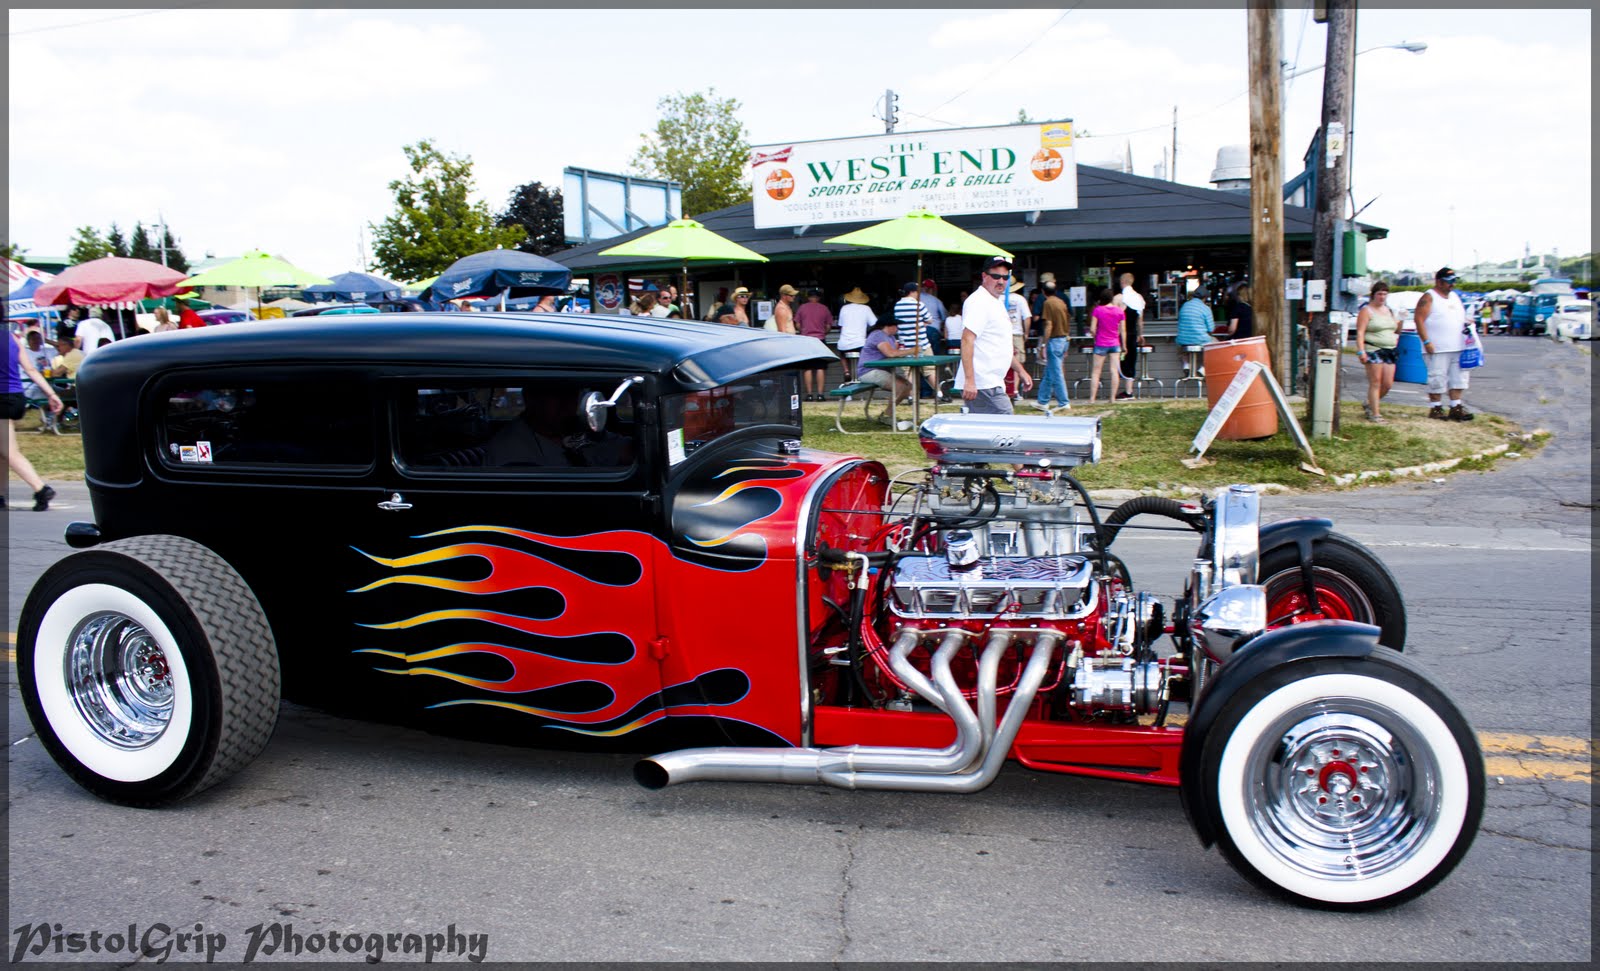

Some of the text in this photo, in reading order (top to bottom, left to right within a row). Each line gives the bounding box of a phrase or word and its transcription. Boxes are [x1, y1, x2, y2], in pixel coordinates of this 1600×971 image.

[889, 142, 928, 153] THE
[806, 147, 1016, 183] WEST END
[808, 172, 1015, 197] SPORTS DECK BAR & GRILLE
[972, 189, 1008, 199] MULTIPLE
[826, 200, 844, 209] BEER
[848, 199, 858, 207] AT
[861, 197, 875, 206] THE
[934, 202, 958, 211] YOUR
[965, 199, 1009, 210] FAVORITE
[1016, 197, 1044, 207] EVENT
[832, 208, 874, 218] BRANDS
